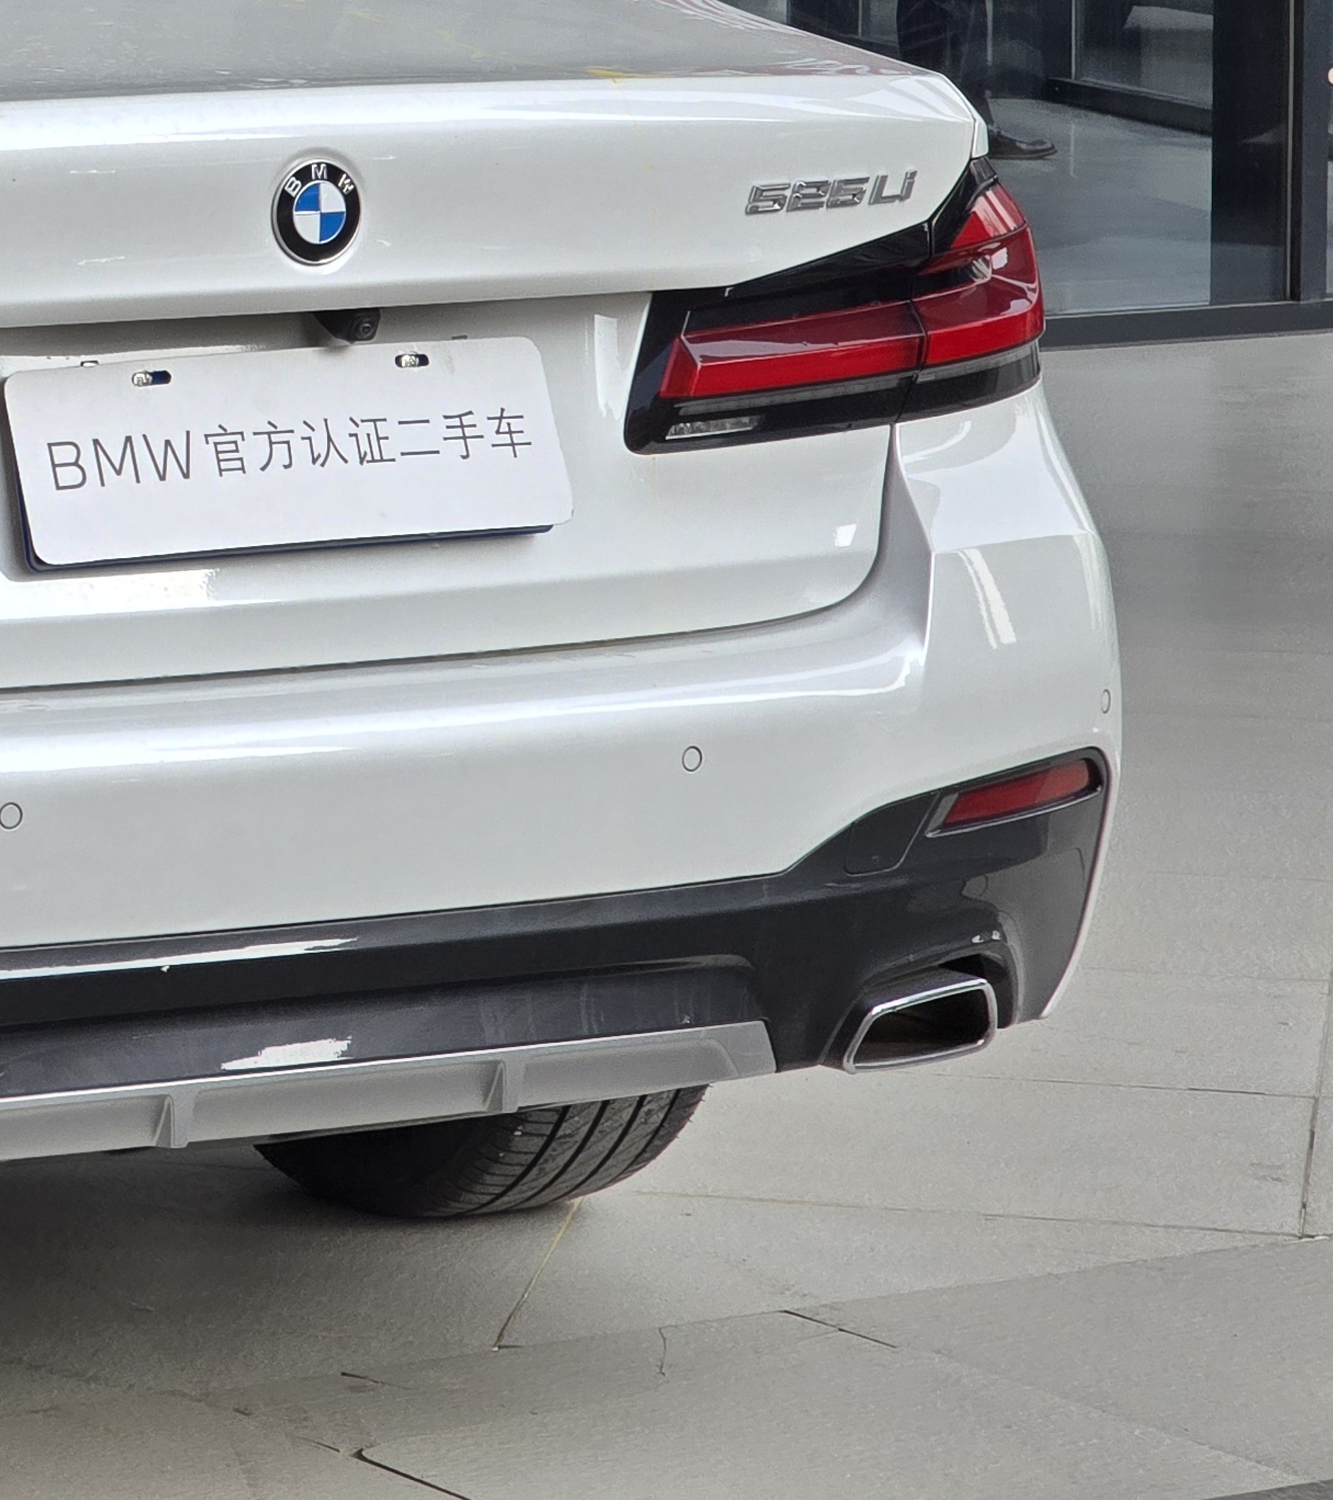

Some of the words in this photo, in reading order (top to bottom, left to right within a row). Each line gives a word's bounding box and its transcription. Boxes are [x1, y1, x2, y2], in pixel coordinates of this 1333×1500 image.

[283, 163, 355, 198] BMW
[745, 170, 918, 216] 525Li
[45, 430, 192, 491] BMW
[203, 407, 533, 478] 官方认证二手车
